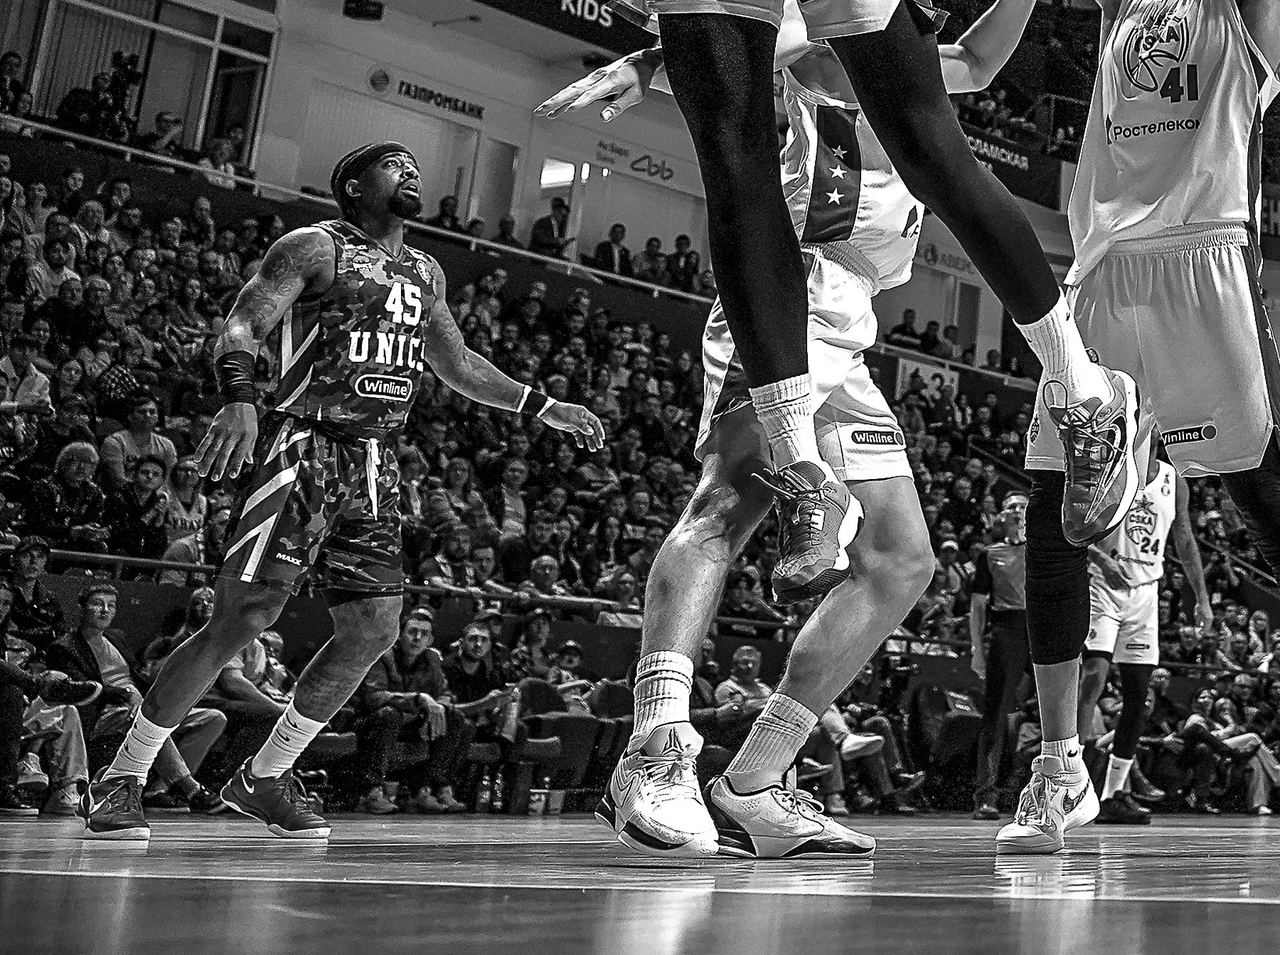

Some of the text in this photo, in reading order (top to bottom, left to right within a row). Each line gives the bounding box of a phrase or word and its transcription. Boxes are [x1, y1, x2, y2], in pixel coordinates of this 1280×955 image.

[1160, 64, 1199, 103] 41
[384, 282, 423, 327] 45
[363, 379, 408, 398] Winline
[853, 432, 895, 445] Winline
[1140, 536, 1160, 556] 24
